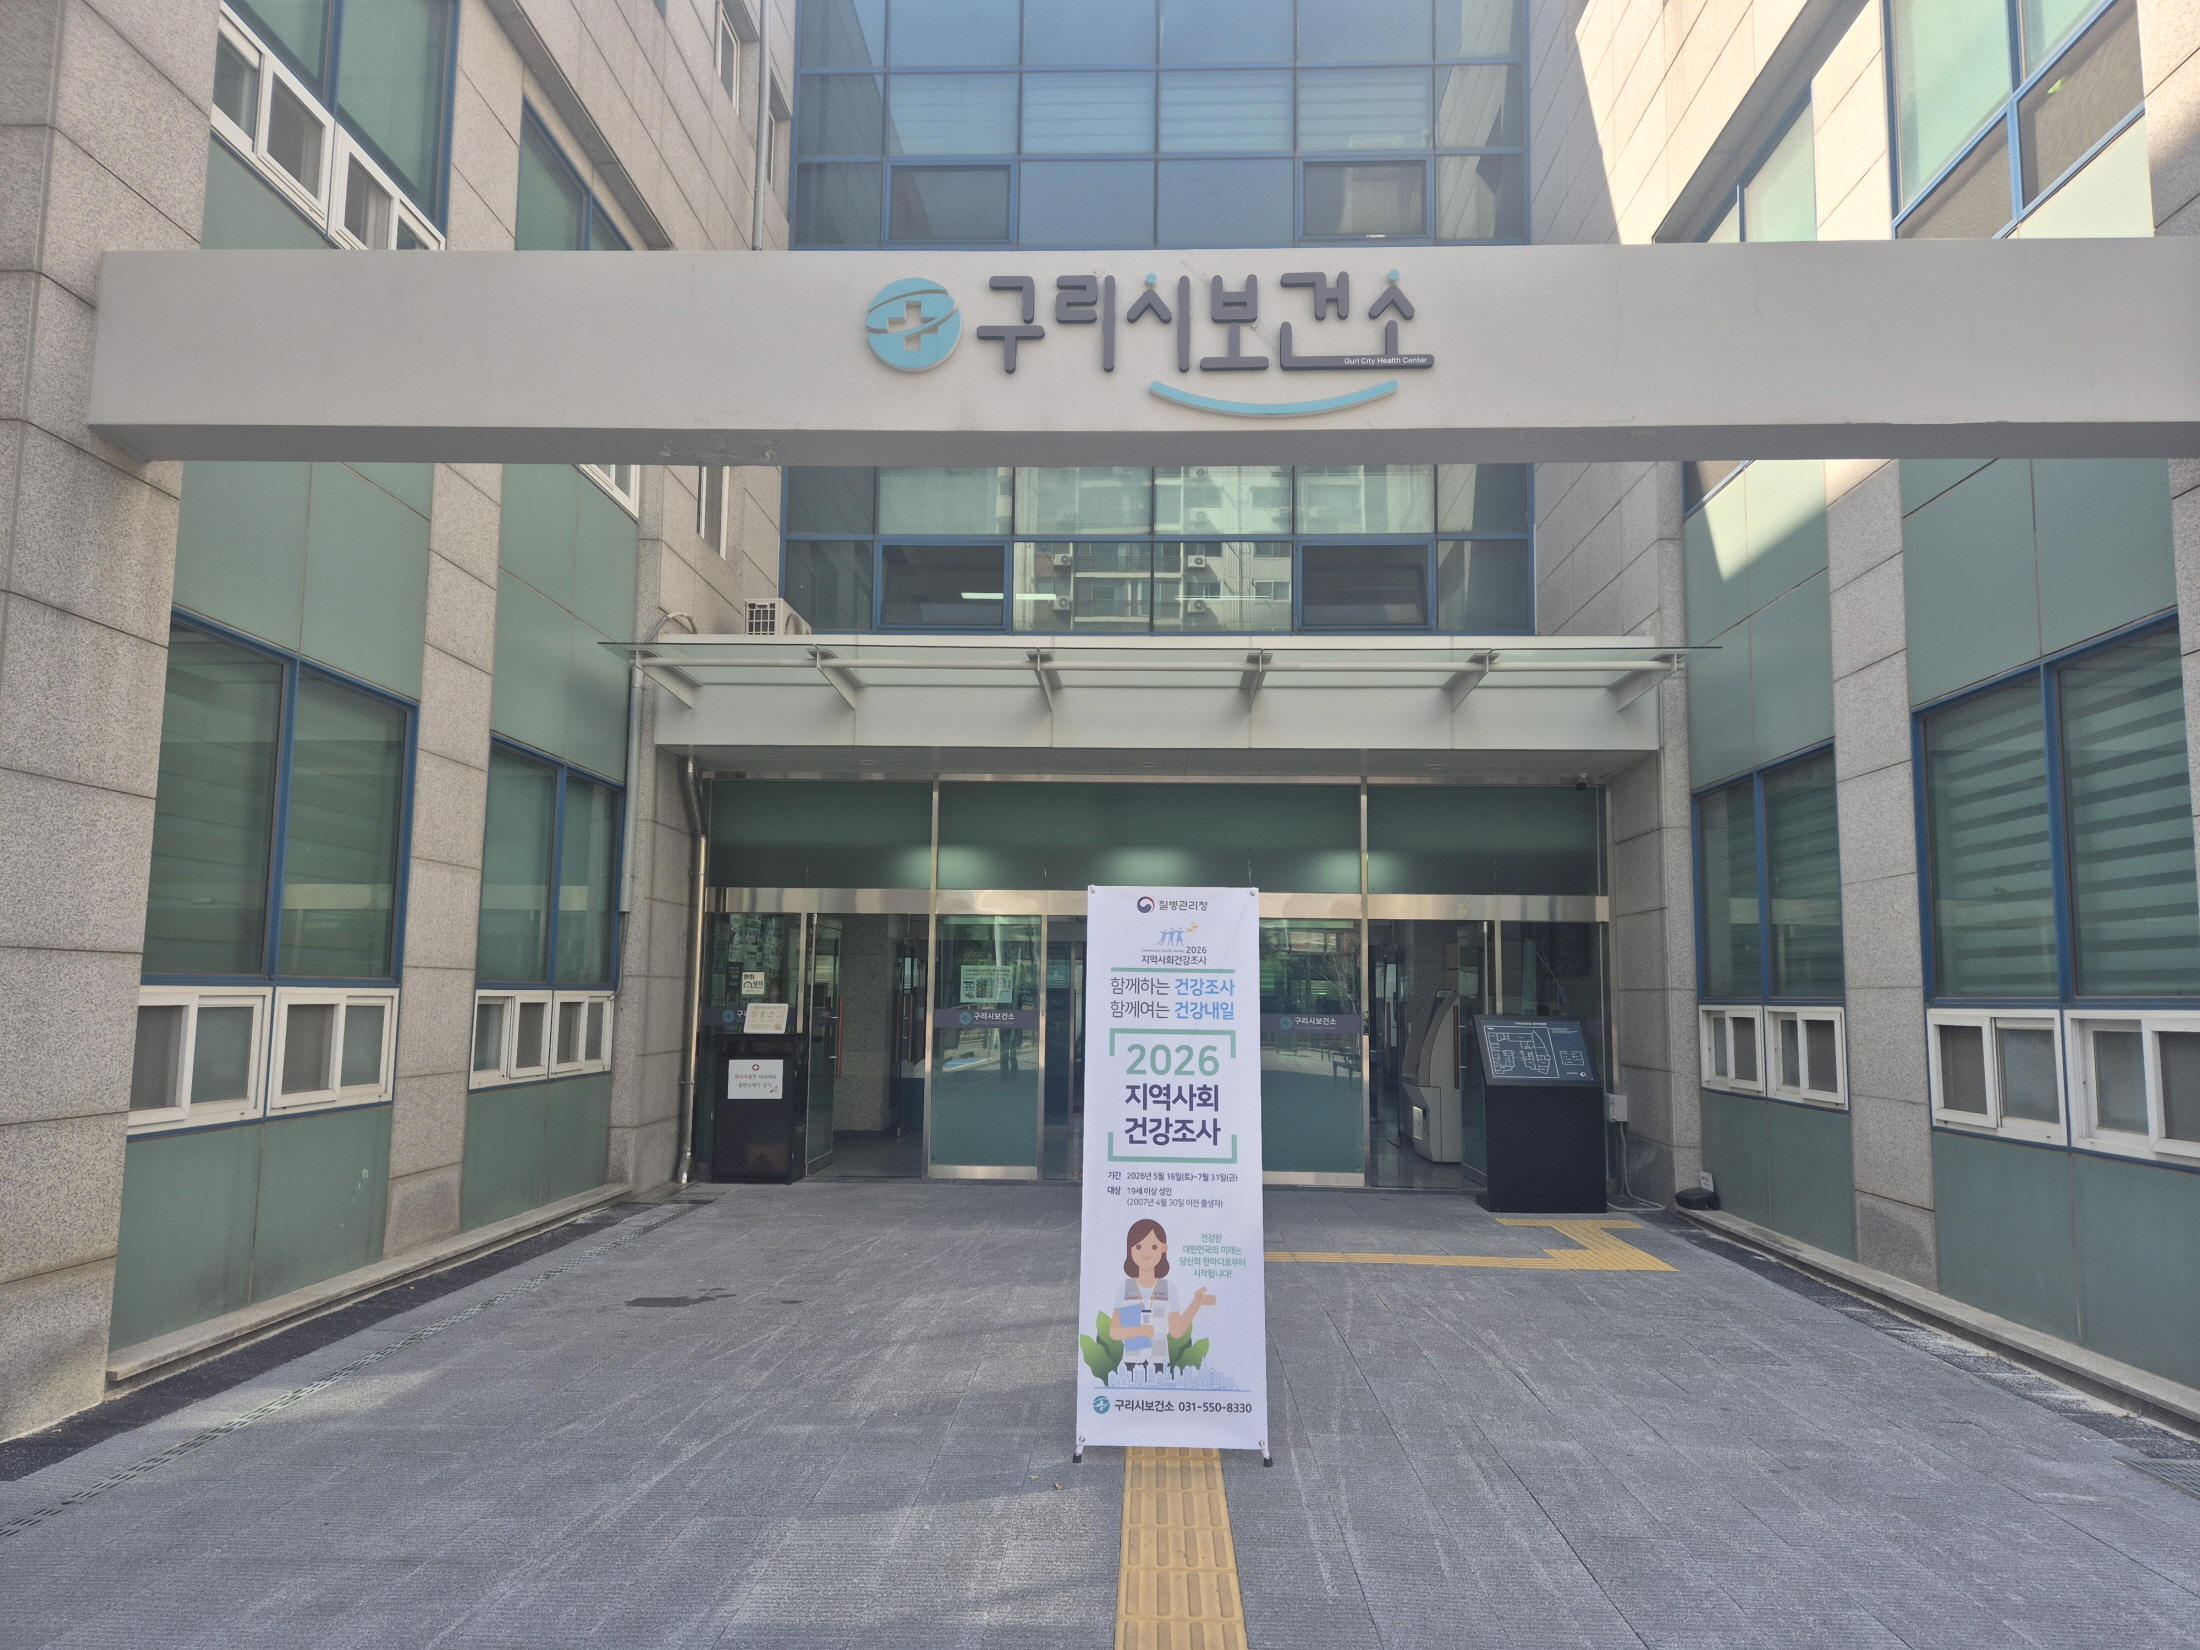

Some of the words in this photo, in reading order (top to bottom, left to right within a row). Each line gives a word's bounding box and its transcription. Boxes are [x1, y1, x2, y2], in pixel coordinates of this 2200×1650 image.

[976, 269, 1435, 374] 구리시보건소
[1361, 357, 1376, 365] City
[1159, 900, 1208, 912] 질병관리청
[1185, 946, 1207, 954] 2026
[1141, 954, 1208, 966] 지역사회건강조사
[1110, 977, 1171, 996] 함께하는
[1174, 977, 1235, 997] 건강조사
[973, 1012, 1015, 1020] 구리시보건소
[1109, 1000, 1170, 1019] 함께여는
[1174, 1001, 1235, 1020] 건강내일
[1294, 1017, 1337, 1025] 구리시보건소
[1126, 1043, 1220, 1077] 2026
[1125, 1083, 1219, 1112] 지역사회
[1124, 1116, 1222, 1146] 건강조사
[1107, 1171, 1122, 1181] 기간
[1126, 1172, 1152, 1181] 2026년
[1153, 1172, 1165, 1181] 5월
[1210, 1173, 1238, 1183] 31일(금)
[1107, 1186, 1121, 1196] 대상
[1127, 1187, 1143, 1196] 19세
[1143, 1187, 1157, 1196] 이상
[1158, 1187, 1172, 1196] 성인
[1126, 1198, 1154, 1208] (2007년
[1155, 1198, 1167, 1208] 4월
[1168, 1198, 1185, 1208] 30일
[1185, 1198, 1200, 1208] 이전
[1200, 1199, 1223, 1208] 출생자)
[1200, 1233, 1222, 1244] 건강한
[1182, 1244, 1219, 1255] 대한민국의
[1220, 1245, 1242, 1256] 미래는
[1179, 1256, 1201, 1267] 당신의
[1202, 1257, 1246, 1267] 한마디로부터
[1193, 1268, 1232, 1279] 시작됩니다!
[1114, 1399, 1175, 1413] 구리시보건소
[1178, 1401, 1252, 1414] 031-550-8330
